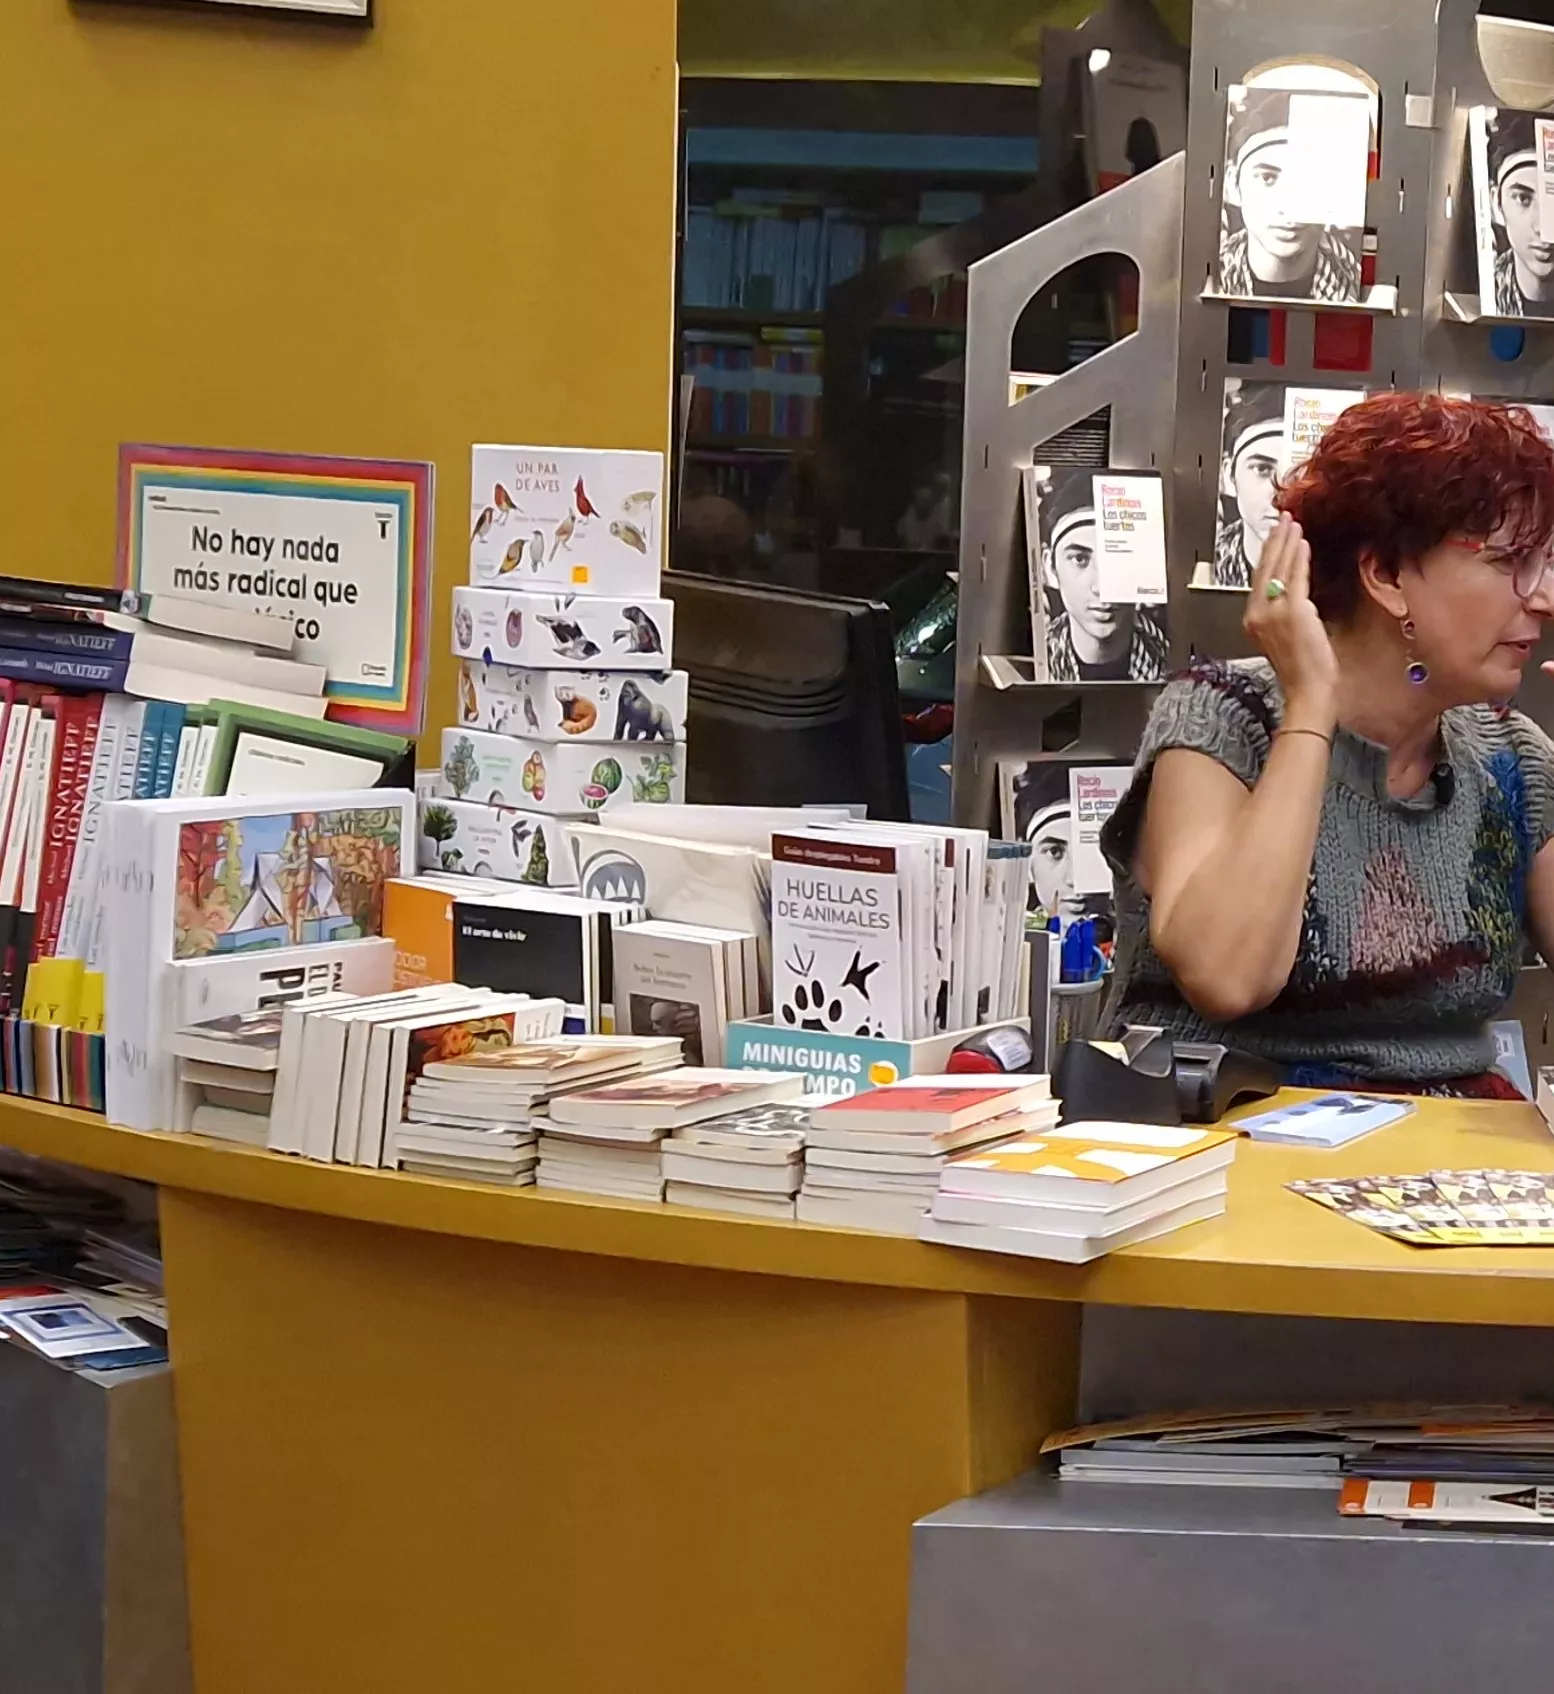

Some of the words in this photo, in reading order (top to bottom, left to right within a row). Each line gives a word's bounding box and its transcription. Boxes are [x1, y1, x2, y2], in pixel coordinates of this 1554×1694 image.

[516, 463, 533, 474] UN
[538, 463, 559, 475] PAR
[516, 480, 531, 491] DE
[535, 480, 560, 492] AVES
[191, 526, 223, 553] No
[231, 528, 275, 561] hay
[282, 536, 339, 563] nada
[174, 562, 220, 591] más
[227, 569, 307, 600] radical
[313, 581, 358, 607] que
[787, 879, 878, 907] HUELLAS
[778, 901, 799, 918] DE
[803, 905, 890, 929] ANIMALES
[742, 1042, 861, 1074] MINIGUIAS
[802, 1074, 857, 1097] MPO
